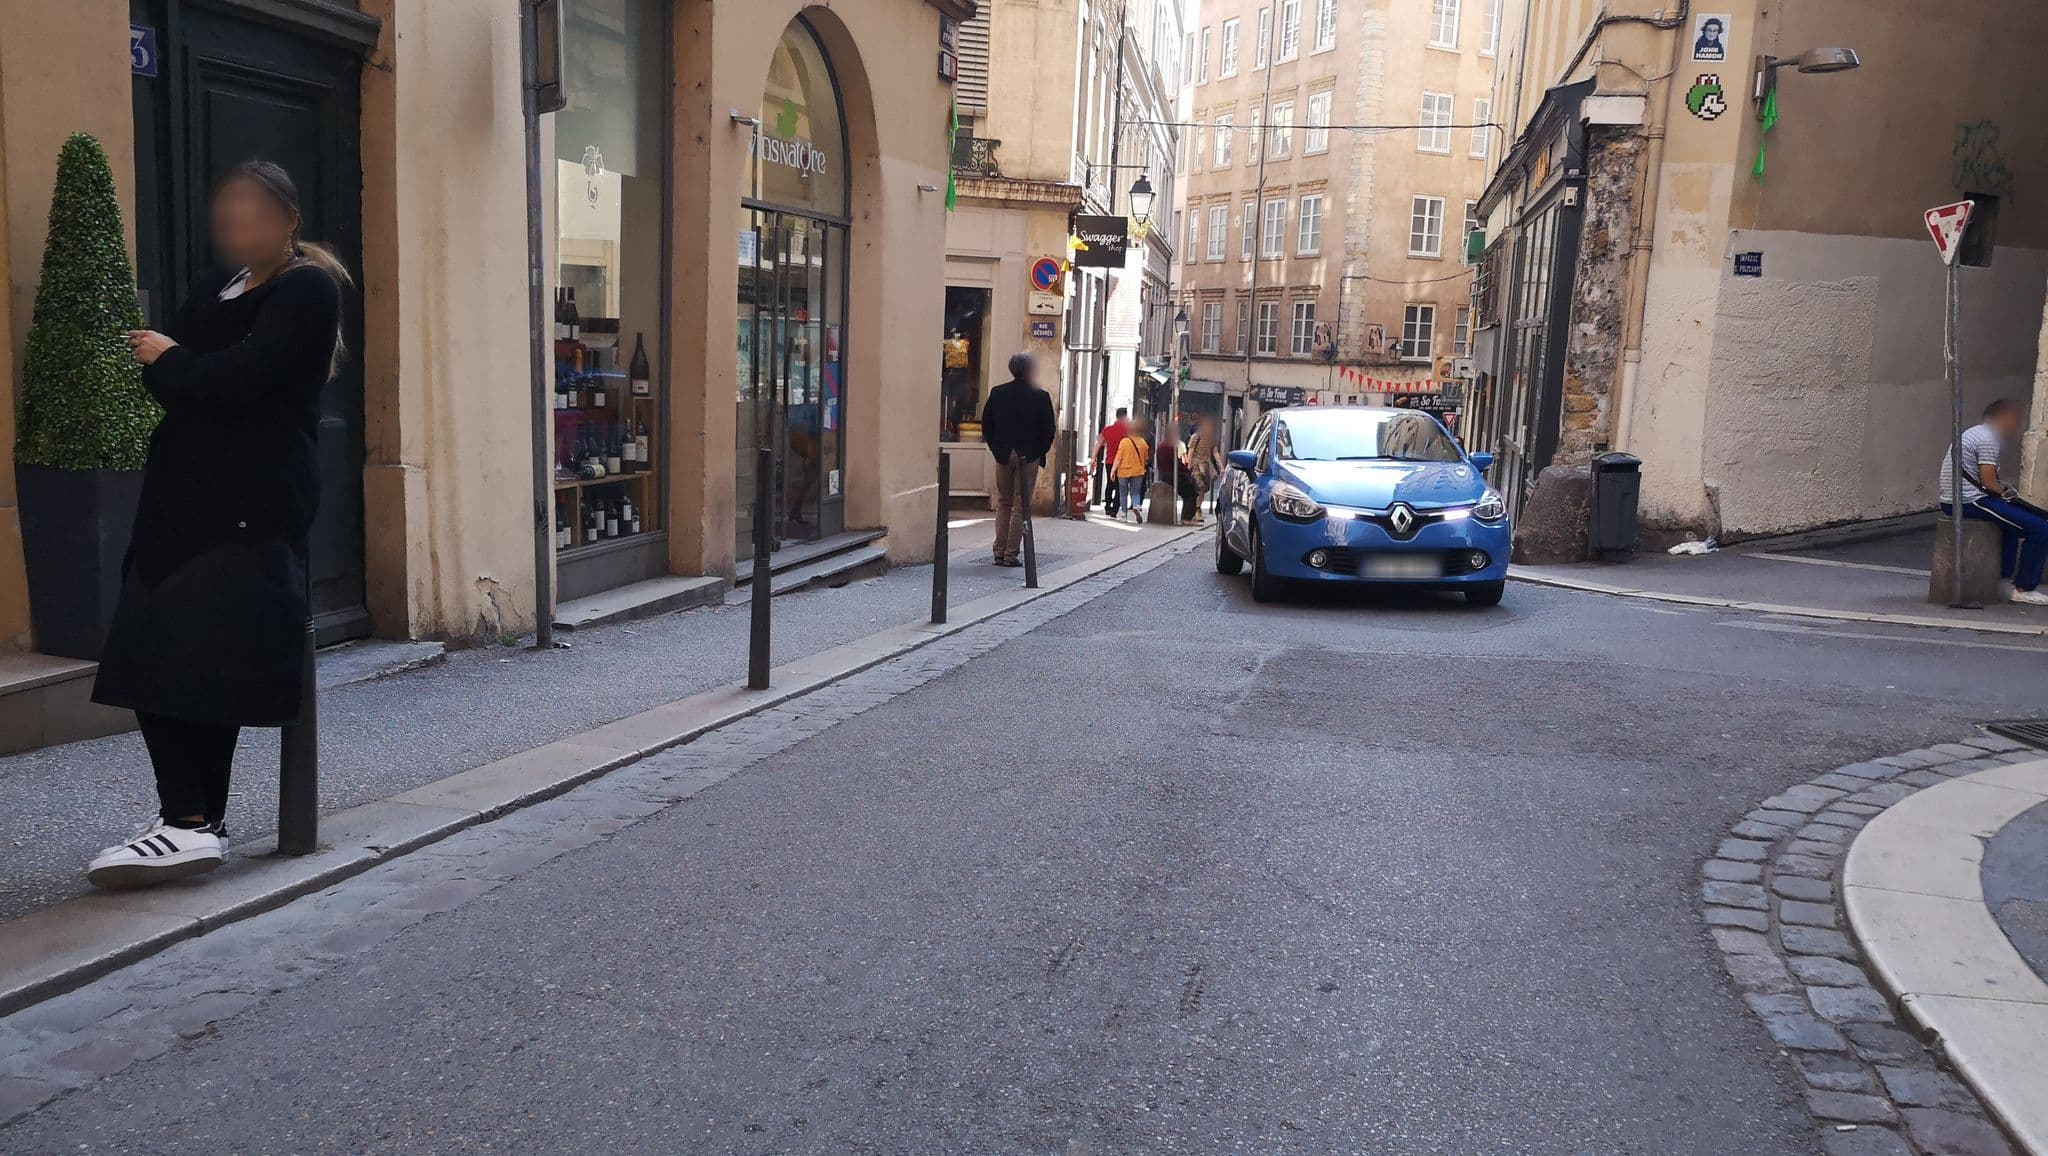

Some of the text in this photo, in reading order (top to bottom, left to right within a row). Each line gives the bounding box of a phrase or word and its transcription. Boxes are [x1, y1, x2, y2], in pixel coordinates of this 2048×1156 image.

[1080, 231, 1124, 246] Swagger
[1266, 388, 1274, 398] So
[1274, 389, 1287, 399] Food
[1421, 395, 1431, 406] So
[1432, 395, 1441, 406] Fo
